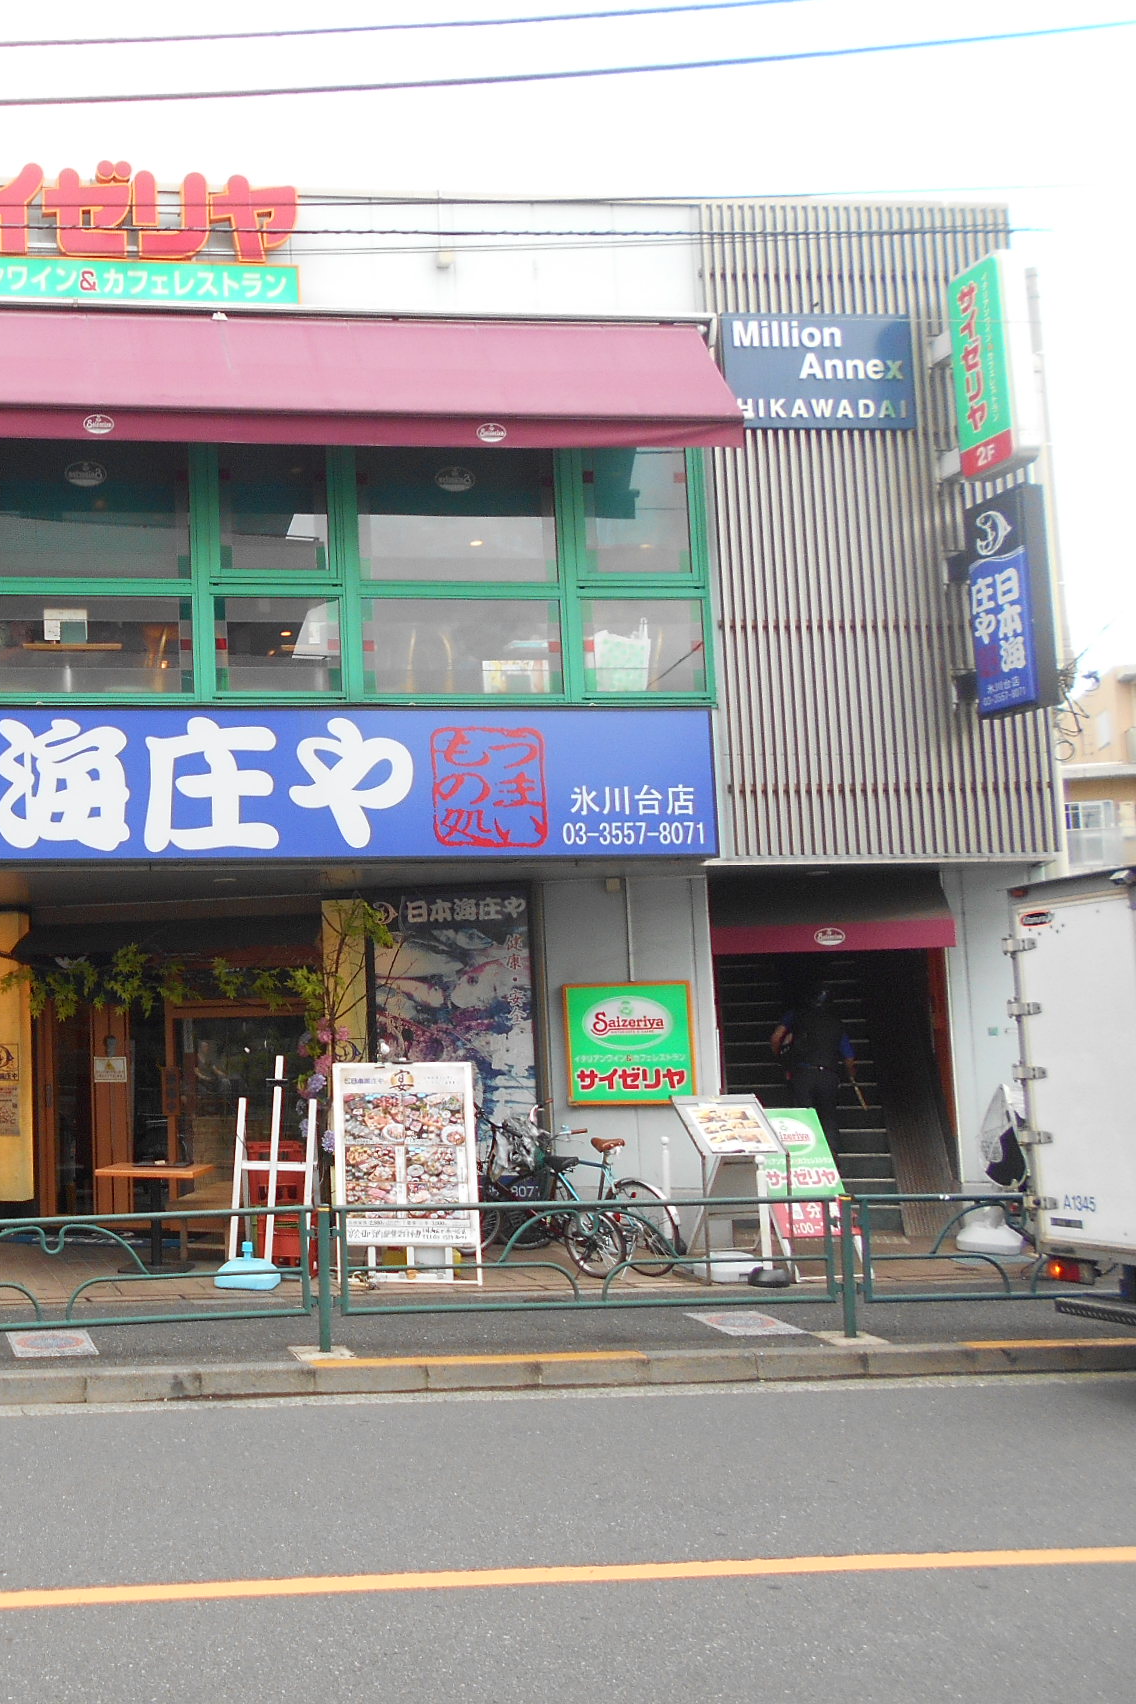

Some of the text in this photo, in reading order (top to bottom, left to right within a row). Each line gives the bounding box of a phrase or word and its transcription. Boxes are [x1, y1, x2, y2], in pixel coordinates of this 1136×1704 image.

[731, 320, 842, 349] Million
[799, 353, 904, 381] Annex
[956, 280, 988, 433] サイゼリヤ
[976, 444, 996, 467] 2F
[569, 784, 695, 817] 氷川台店
[562, 821, 706, 846] 03-3557-8071
[406, 896, 526, 923] 日本海庄や
[506, 933, 527, 1026] 健康・安全
[591, 1010, 664, 1034] Saizeriya
[576, 1066, 686, 1091] サイゼリヤ
[778, 1131, 811, 1141] izeriya
[1063, 1194, 1096, 1212] A1345
